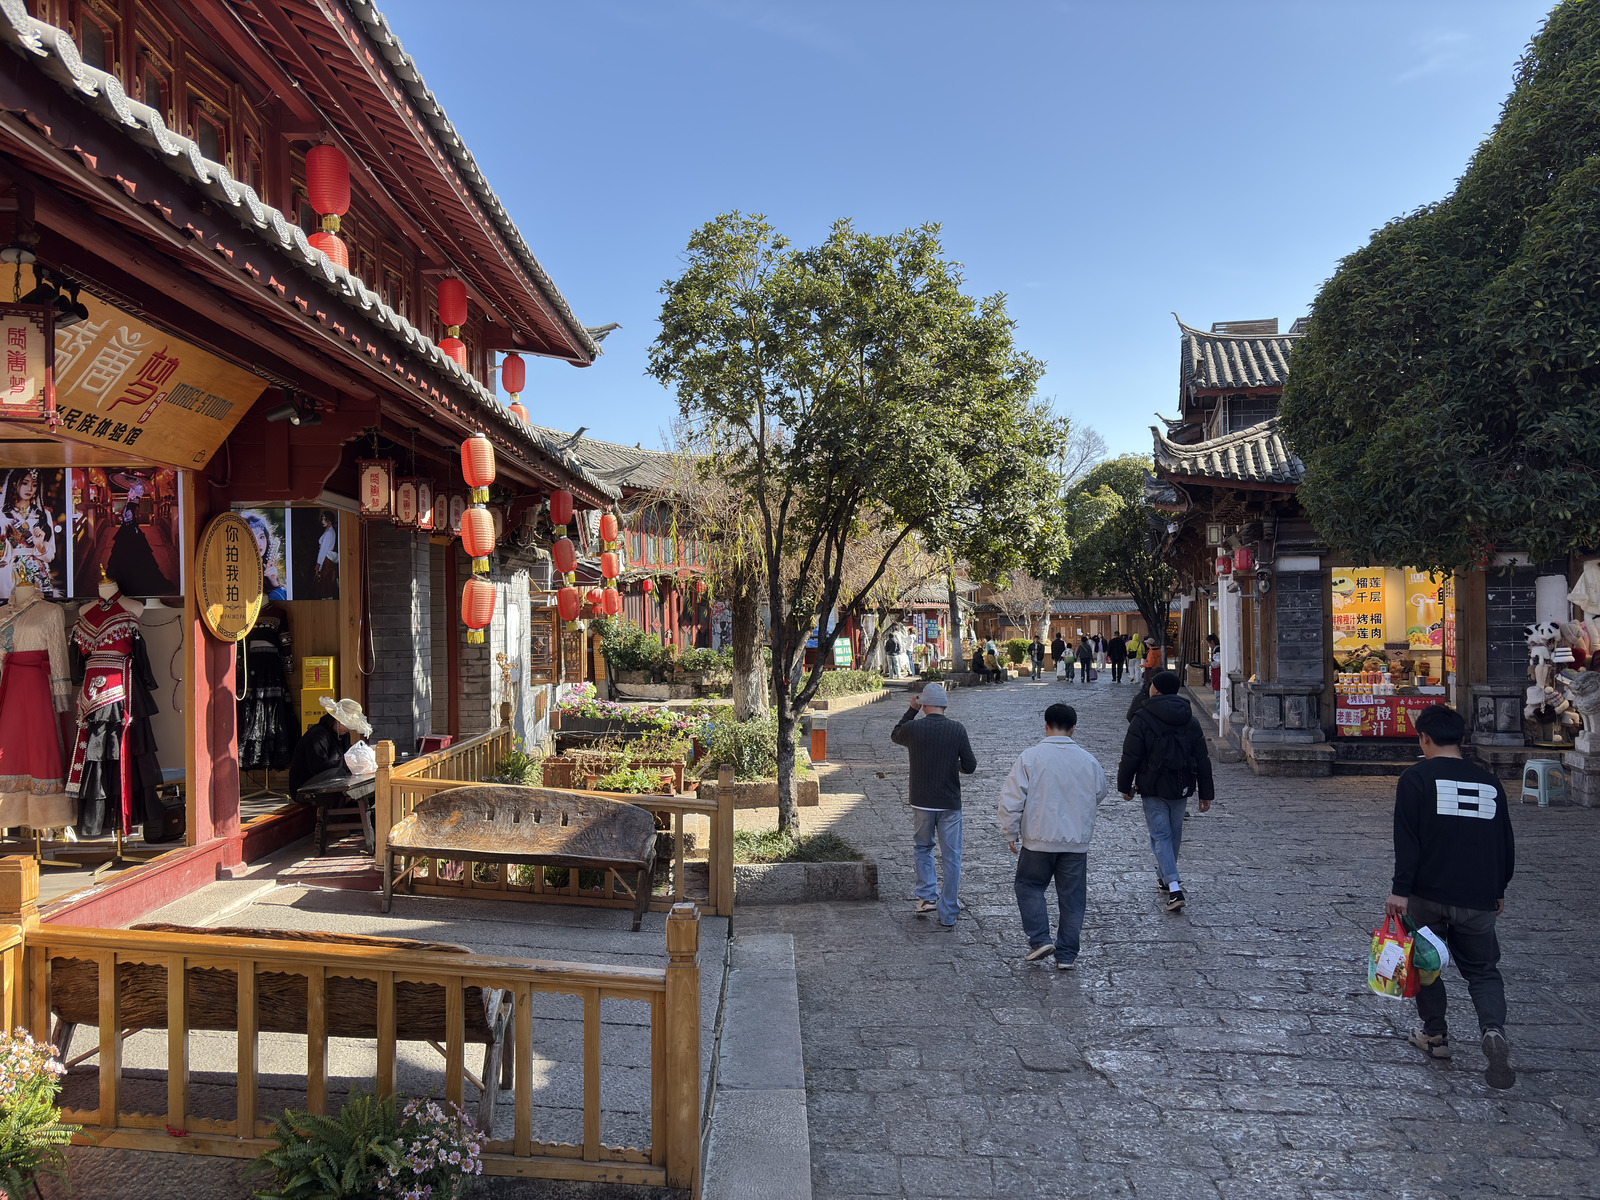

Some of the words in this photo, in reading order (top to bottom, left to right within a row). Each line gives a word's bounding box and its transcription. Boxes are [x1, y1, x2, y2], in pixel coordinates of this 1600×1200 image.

[165, 382, 206, 411] IMAGE
[195, 394, 235, 421] STUDIO
[56, 404, 144, 446] 民族体验馆
[225, 524, 239, 602] 你拍我拍
[1356, 577, 1382, 589] 榴莲
[1356, 591, 1382, 603] 千层
[1356, 613, 1382, 625] 烤榴
[1357, 628, 1382, 639] 莲肉
[1396, 706, 1406, 733] 烤乳扇
